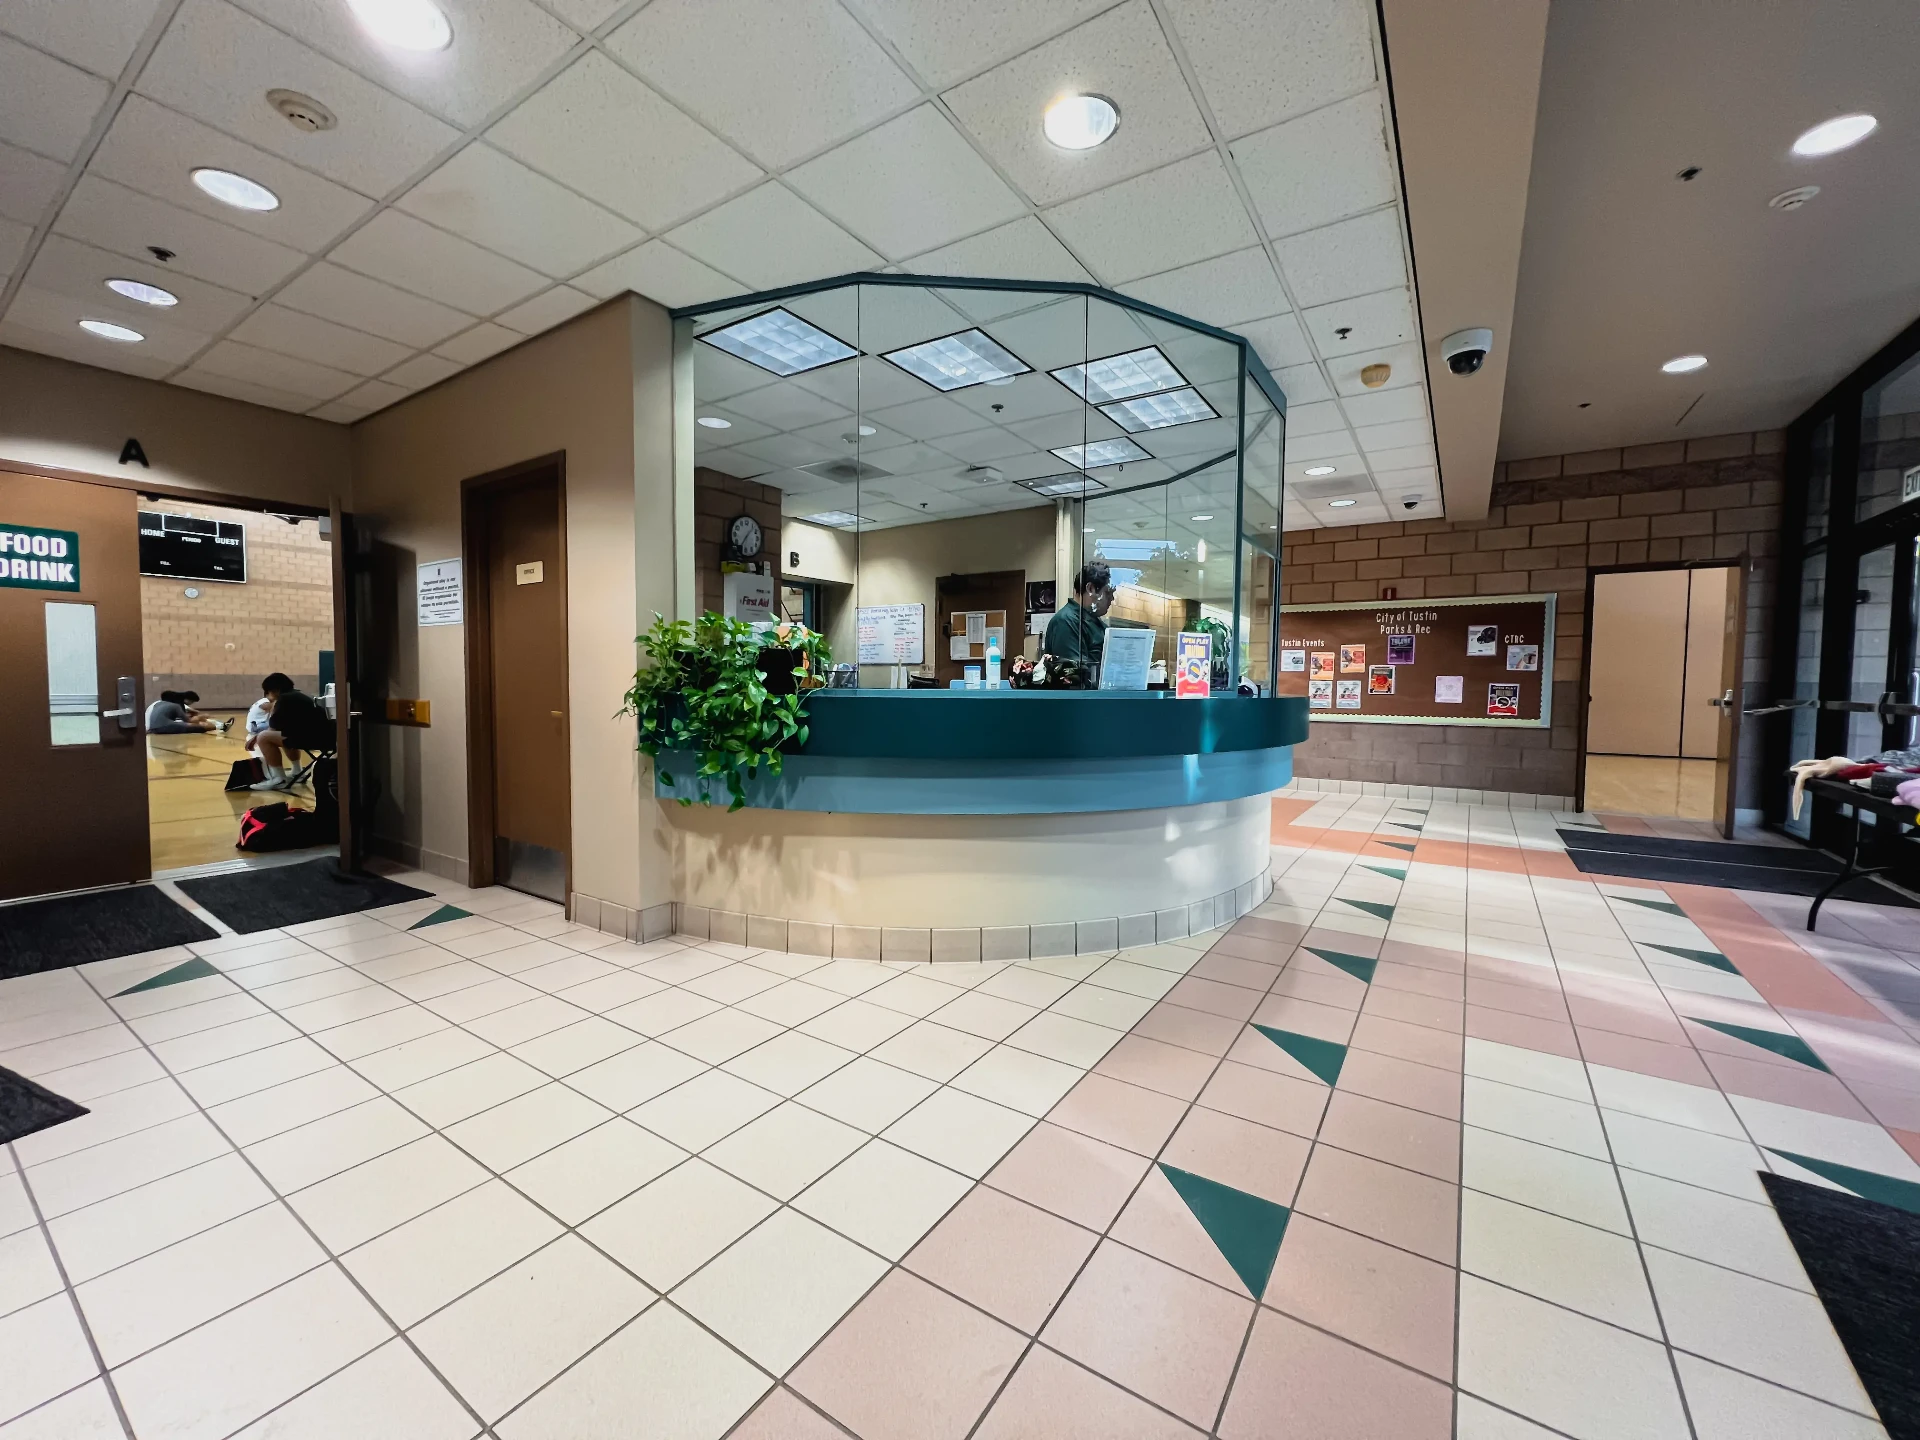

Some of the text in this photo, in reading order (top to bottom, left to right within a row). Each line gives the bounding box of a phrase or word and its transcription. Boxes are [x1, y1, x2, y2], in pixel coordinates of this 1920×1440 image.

[118, 438, 150, 468] A
[140, 528, 166, 538] HOME
[0, 532, 67, 557] FOOD
[214, 537, 240, 546] GUEST
[789, 551, 800, 568] B
[0, 557, 75, 583] DRINK
[742, 595, 770, 608] First Aid
[1376, 610, 1438, 624] City of Tustin
[1380, 624, 1406, 635] Parks
[1415, 624, 1431, 634] Rec
[1302, 638, 1325, 647] Events
[1504, 634, 1525, 644] CTRC
